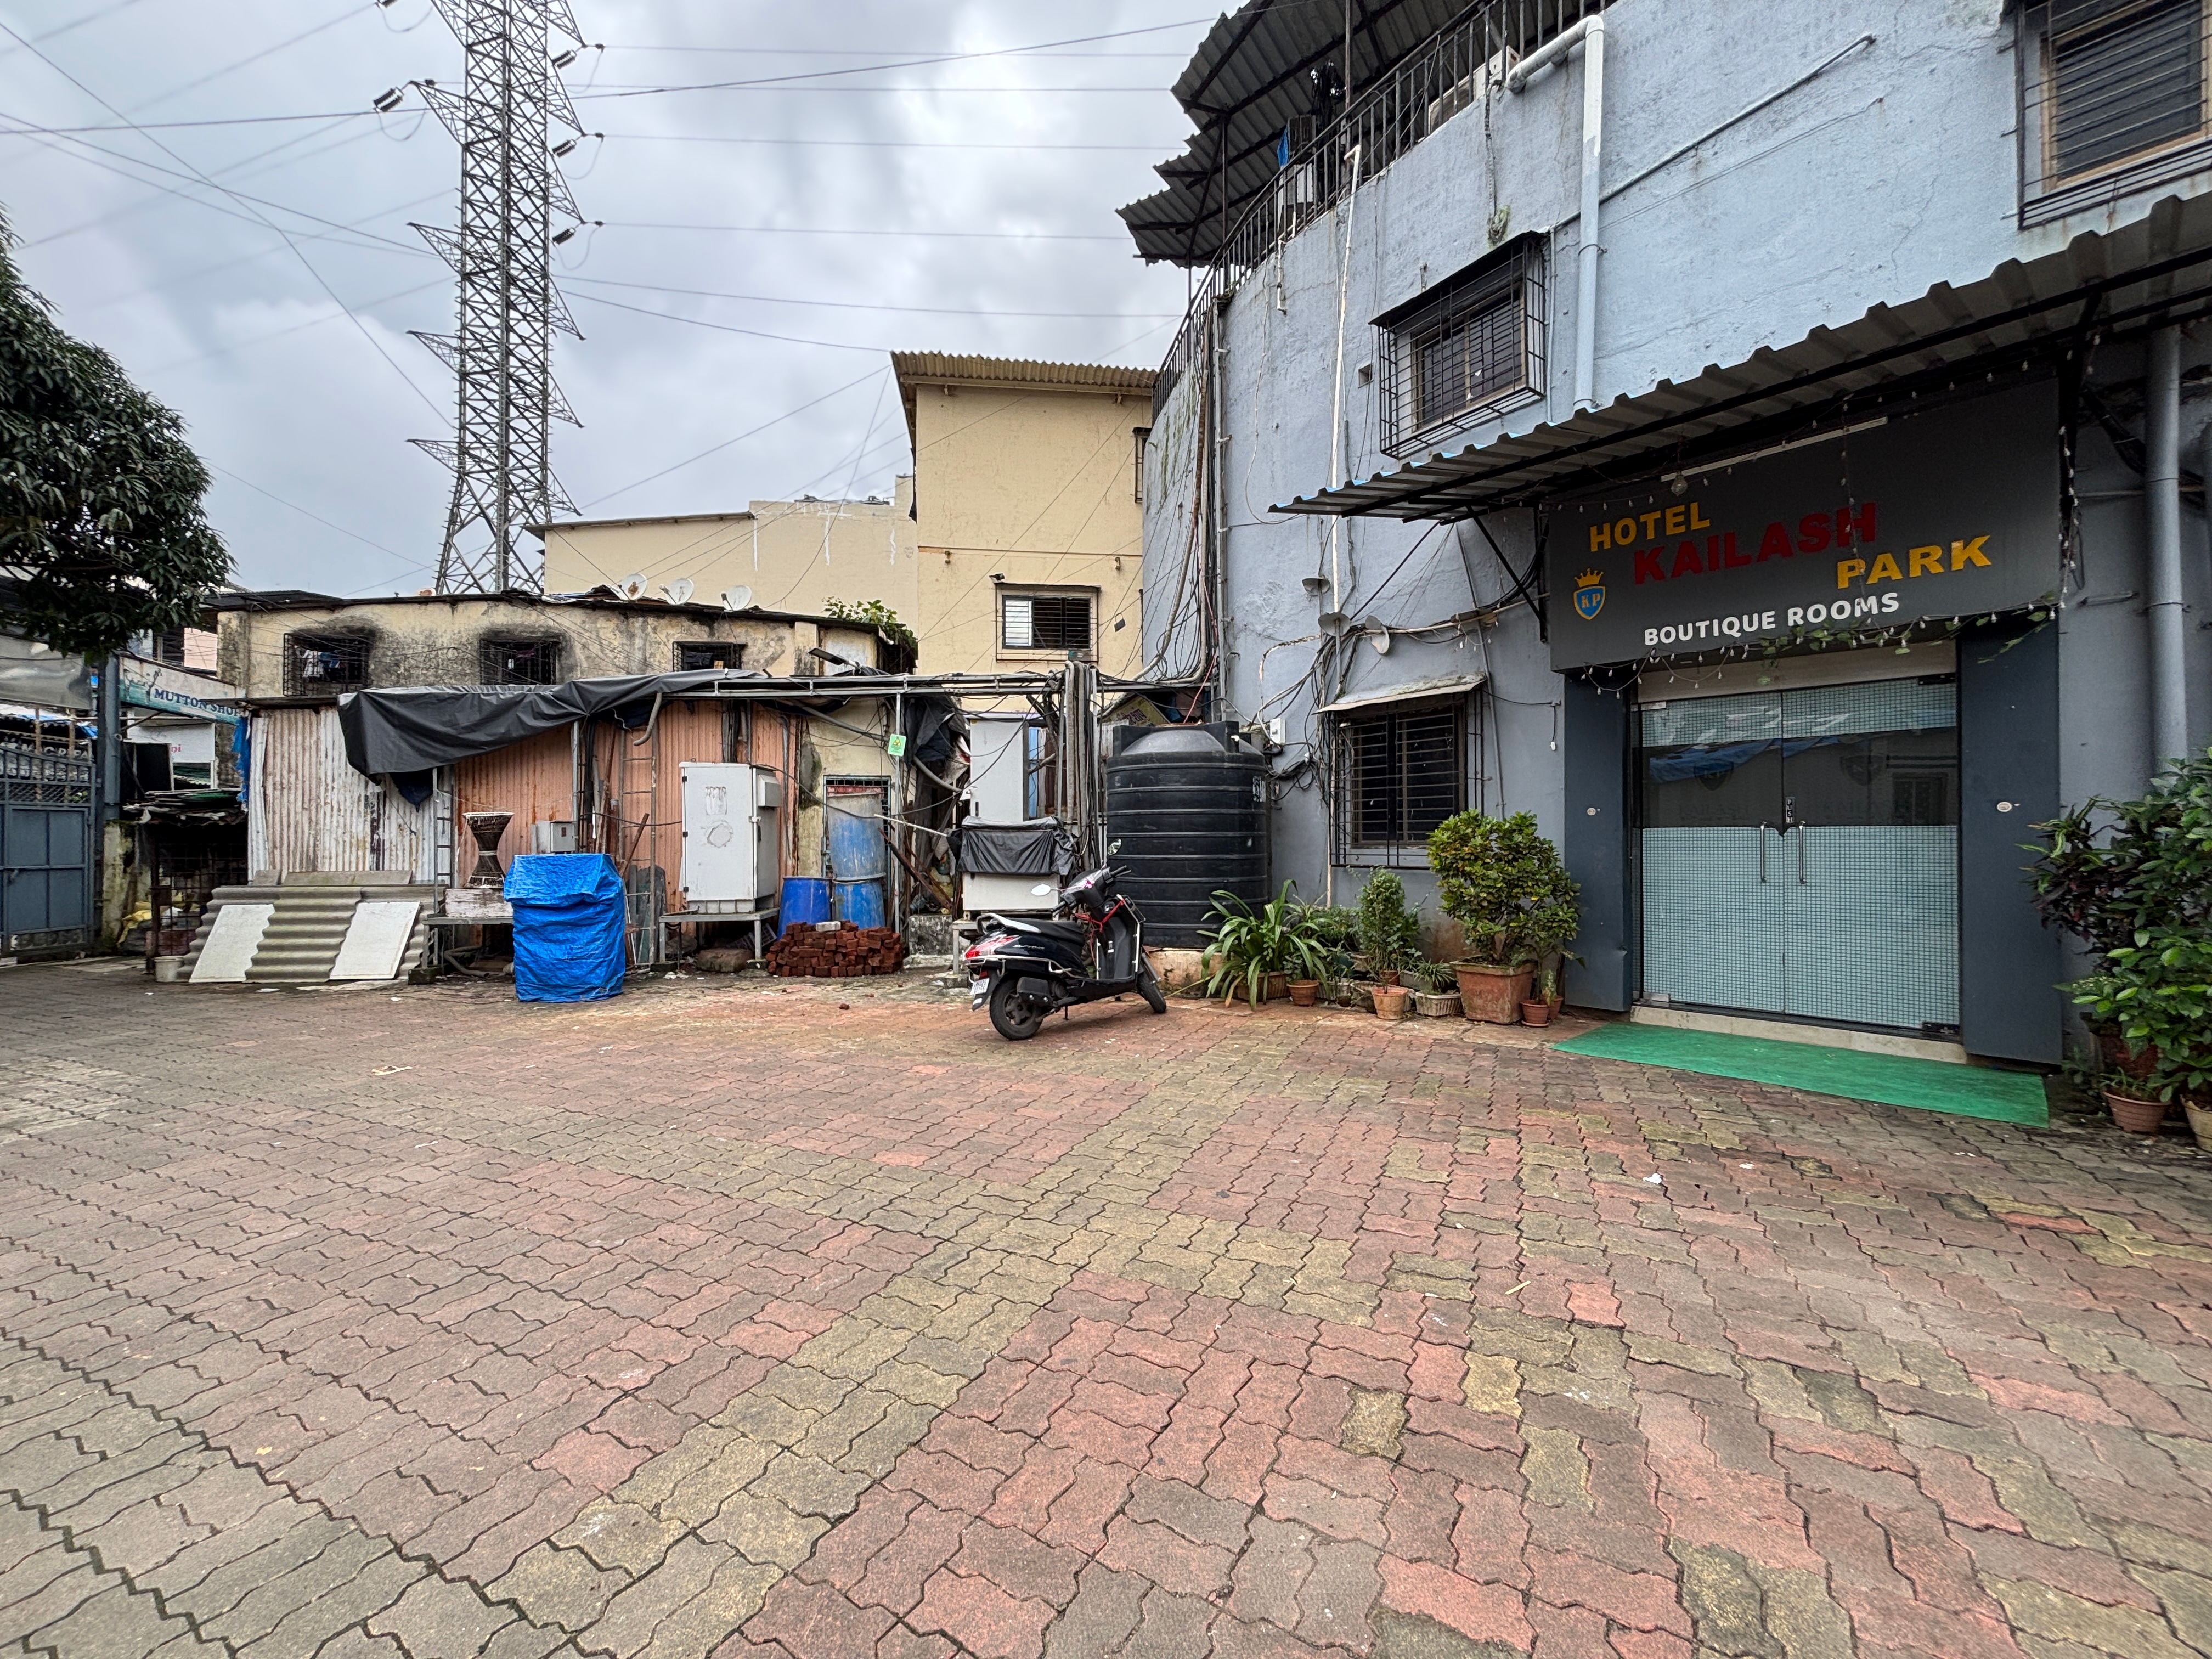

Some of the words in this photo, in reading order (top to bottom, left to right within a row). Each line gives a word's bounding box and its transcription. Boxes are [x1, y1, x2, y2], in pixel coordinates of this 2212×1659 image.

[1590, 502, 1710, 552] HOTEL
[1634, 501, 1876, 585] KAILASH
[1837, 535, 1992, 589] PARK
[1645, 611, 1775, 646] BOUTIQUE
[1787, 592, 1899, 627] ROOMS
[155, 688, 207, 710] MUTTON
